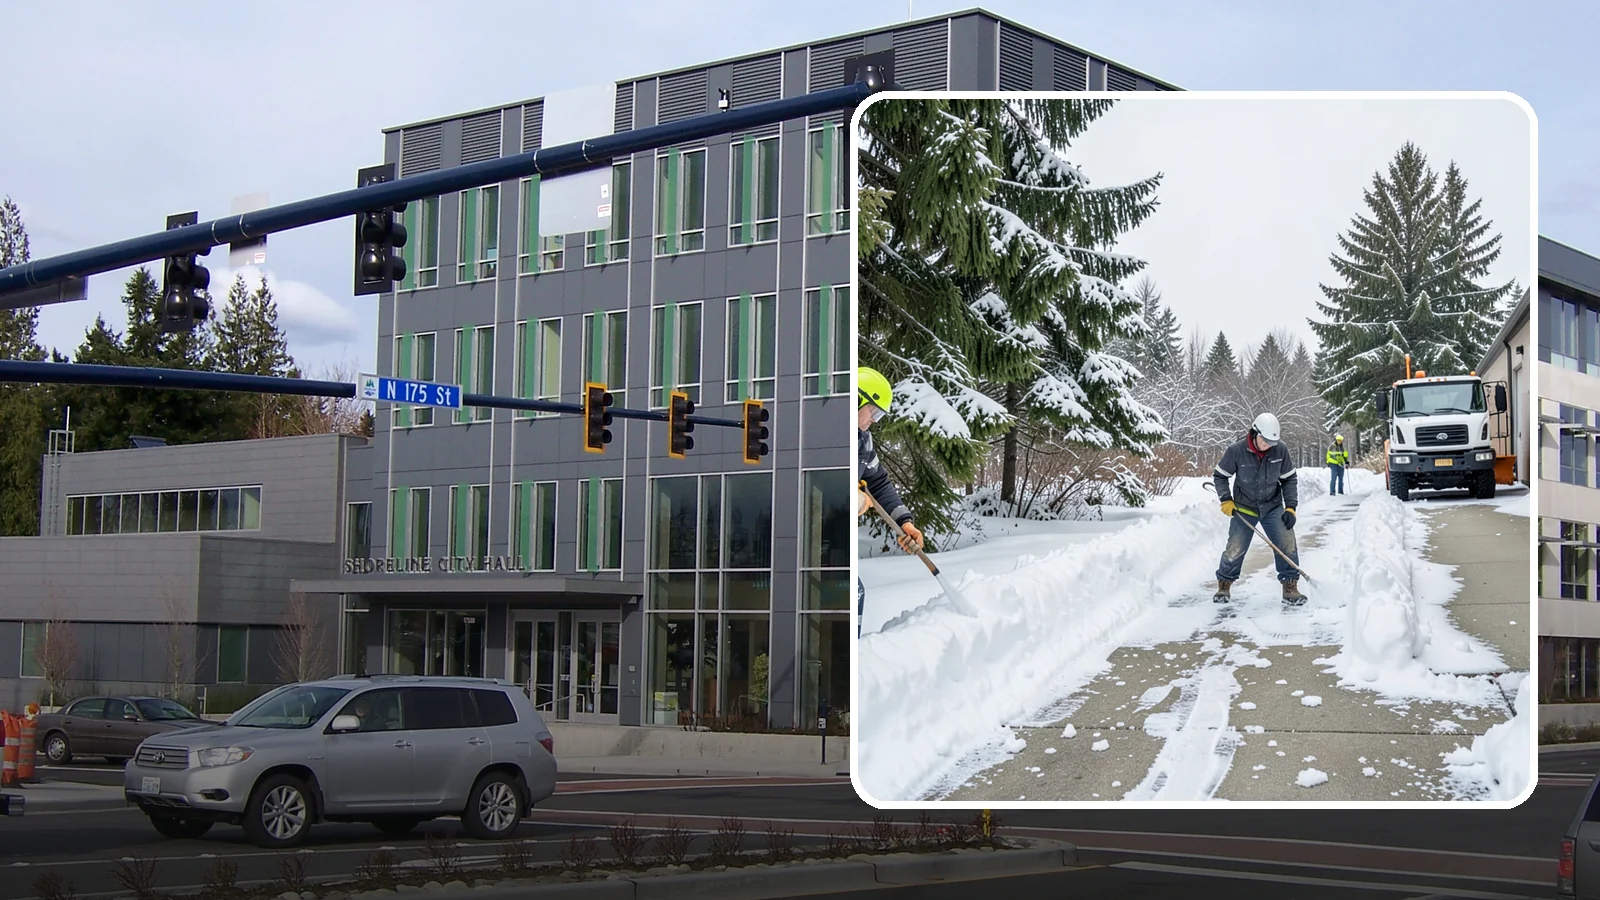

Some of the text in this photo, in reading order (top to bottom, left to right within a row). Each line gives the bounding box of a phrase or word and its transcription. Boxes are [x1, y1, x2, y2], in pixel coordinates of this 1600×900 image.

[387, 380, 452, 406] N 175 St
[344, 555, 524, 574] SHORELINE CITY HALL
